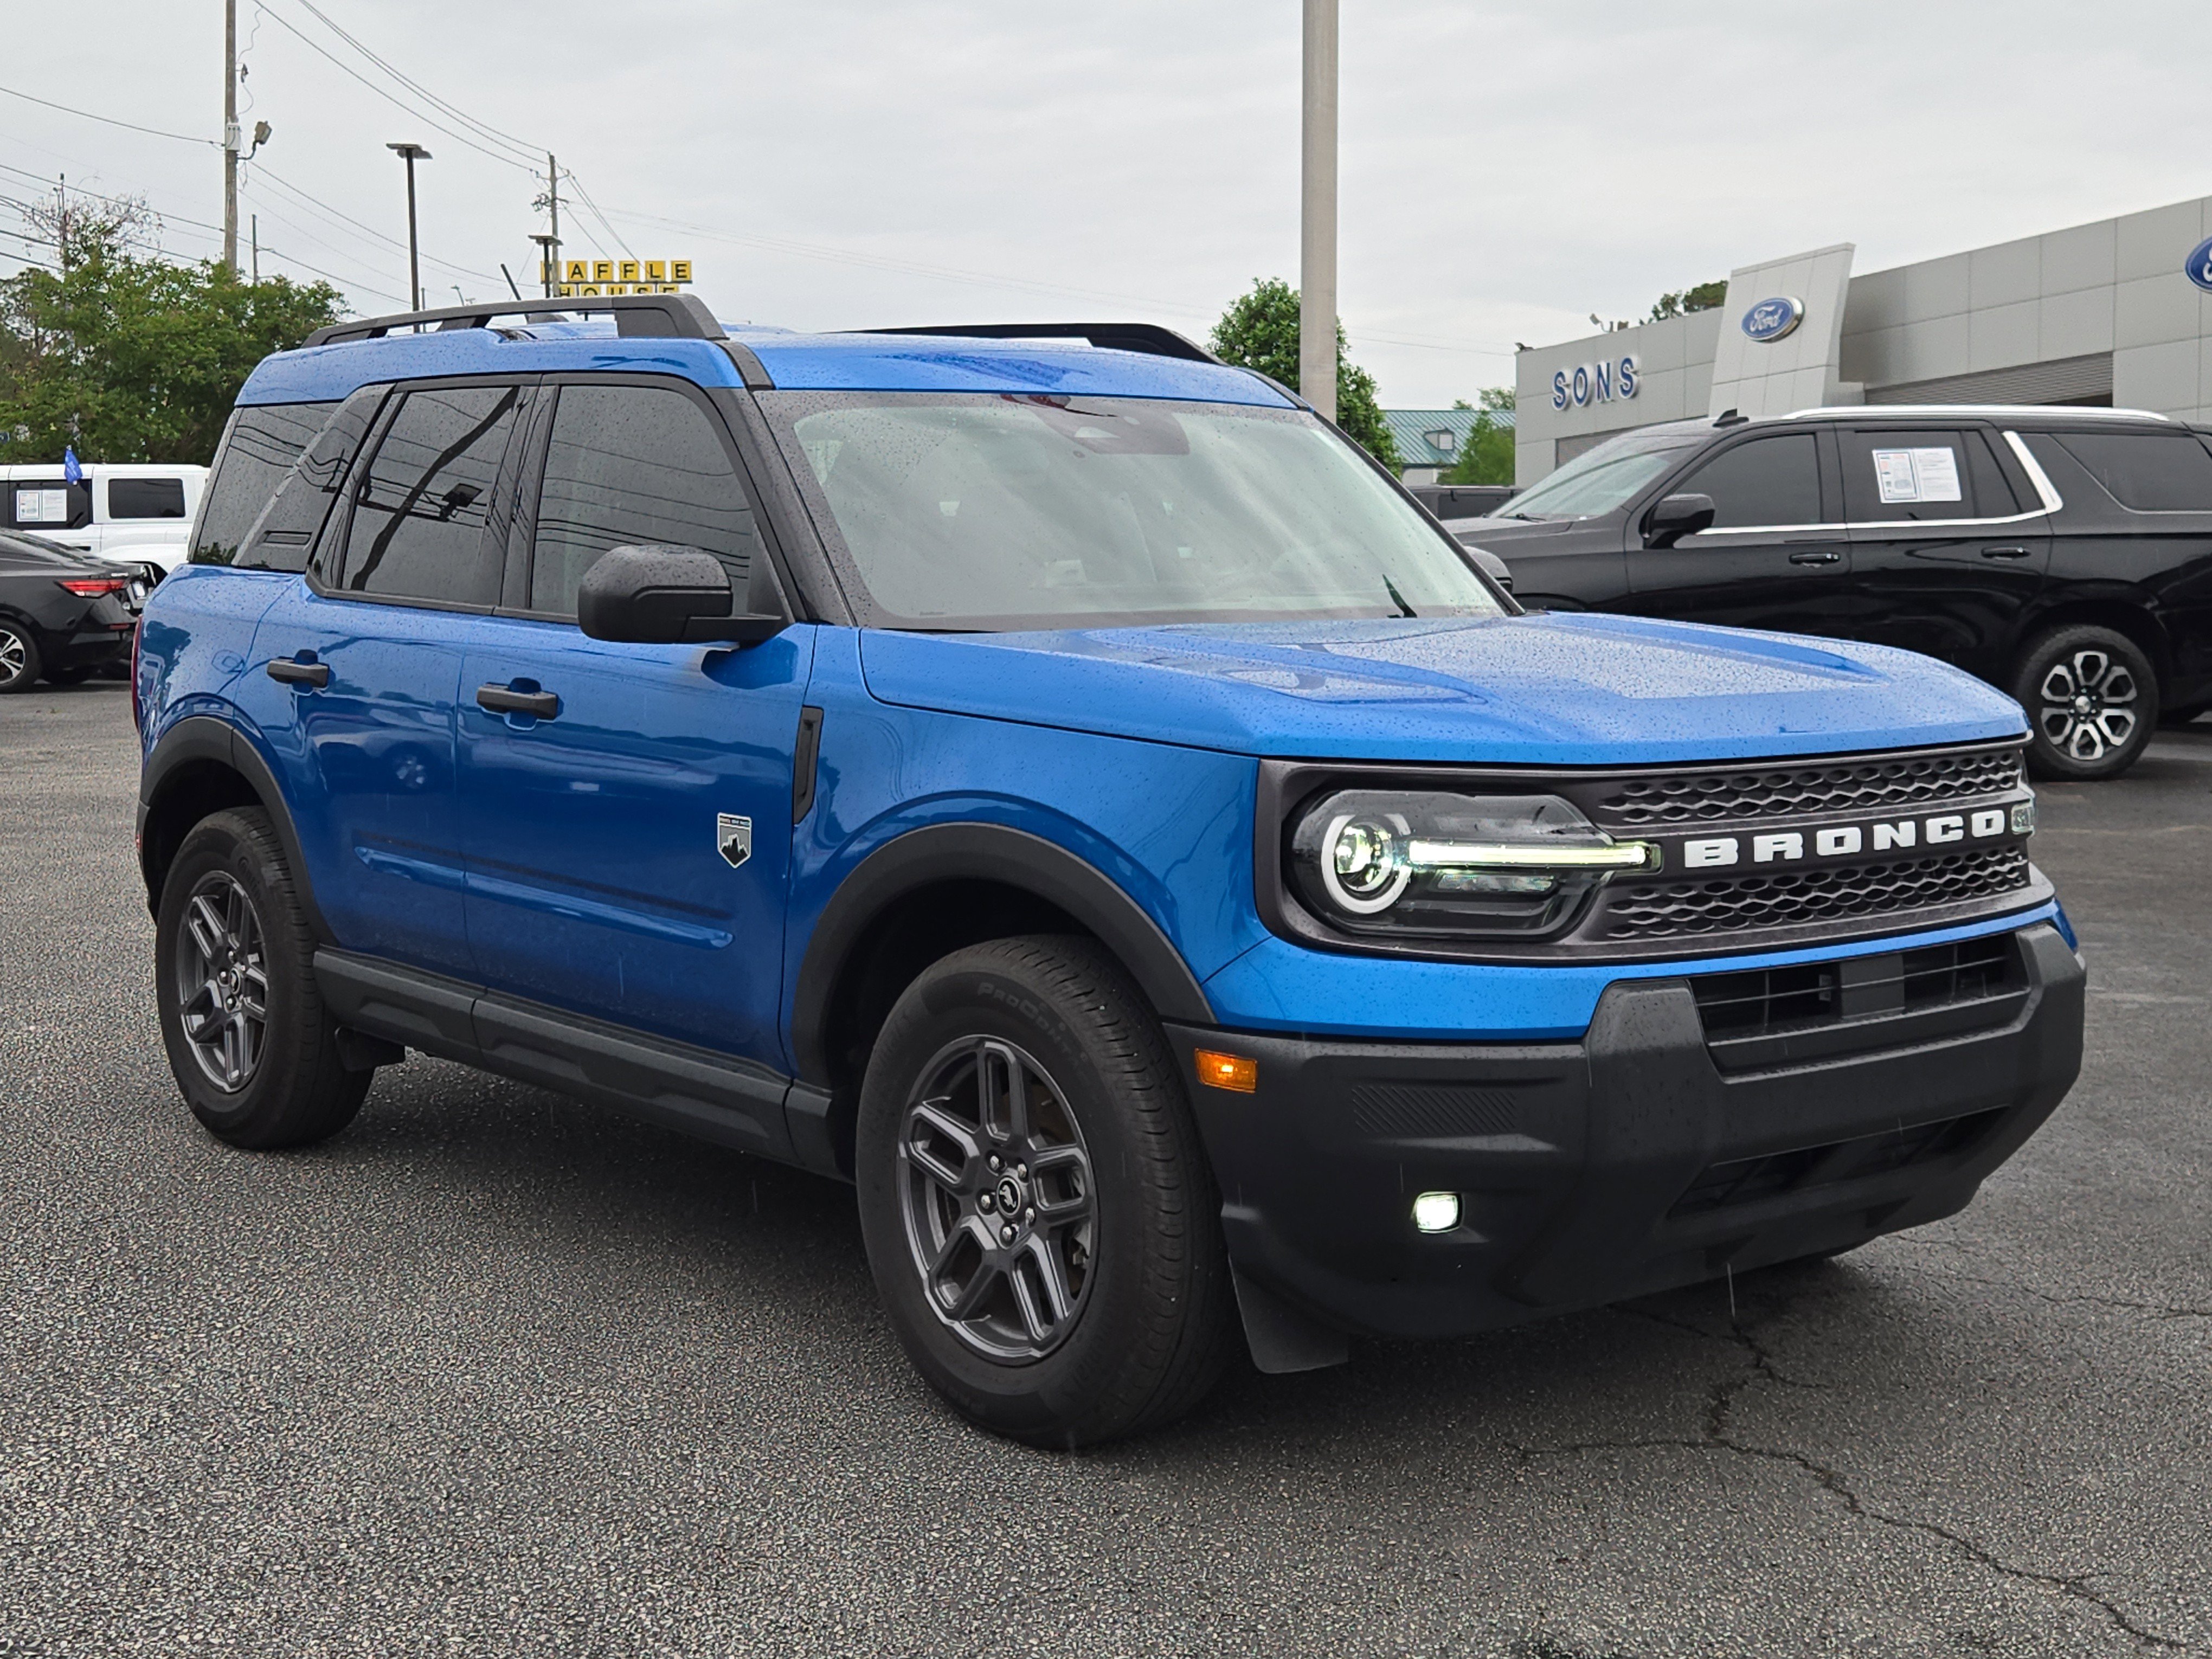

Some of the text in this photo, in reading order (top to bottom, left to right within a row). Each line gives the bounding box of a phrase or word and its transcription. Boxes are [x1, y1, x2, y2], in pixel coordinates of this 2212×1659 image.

[544, 263, 687, 278] AFFLE
[1750, 305, 1784, 332] Ford
[1552, 357, 1636, 410] SONS
[1684, 810, 2005, 867] BRONCO
